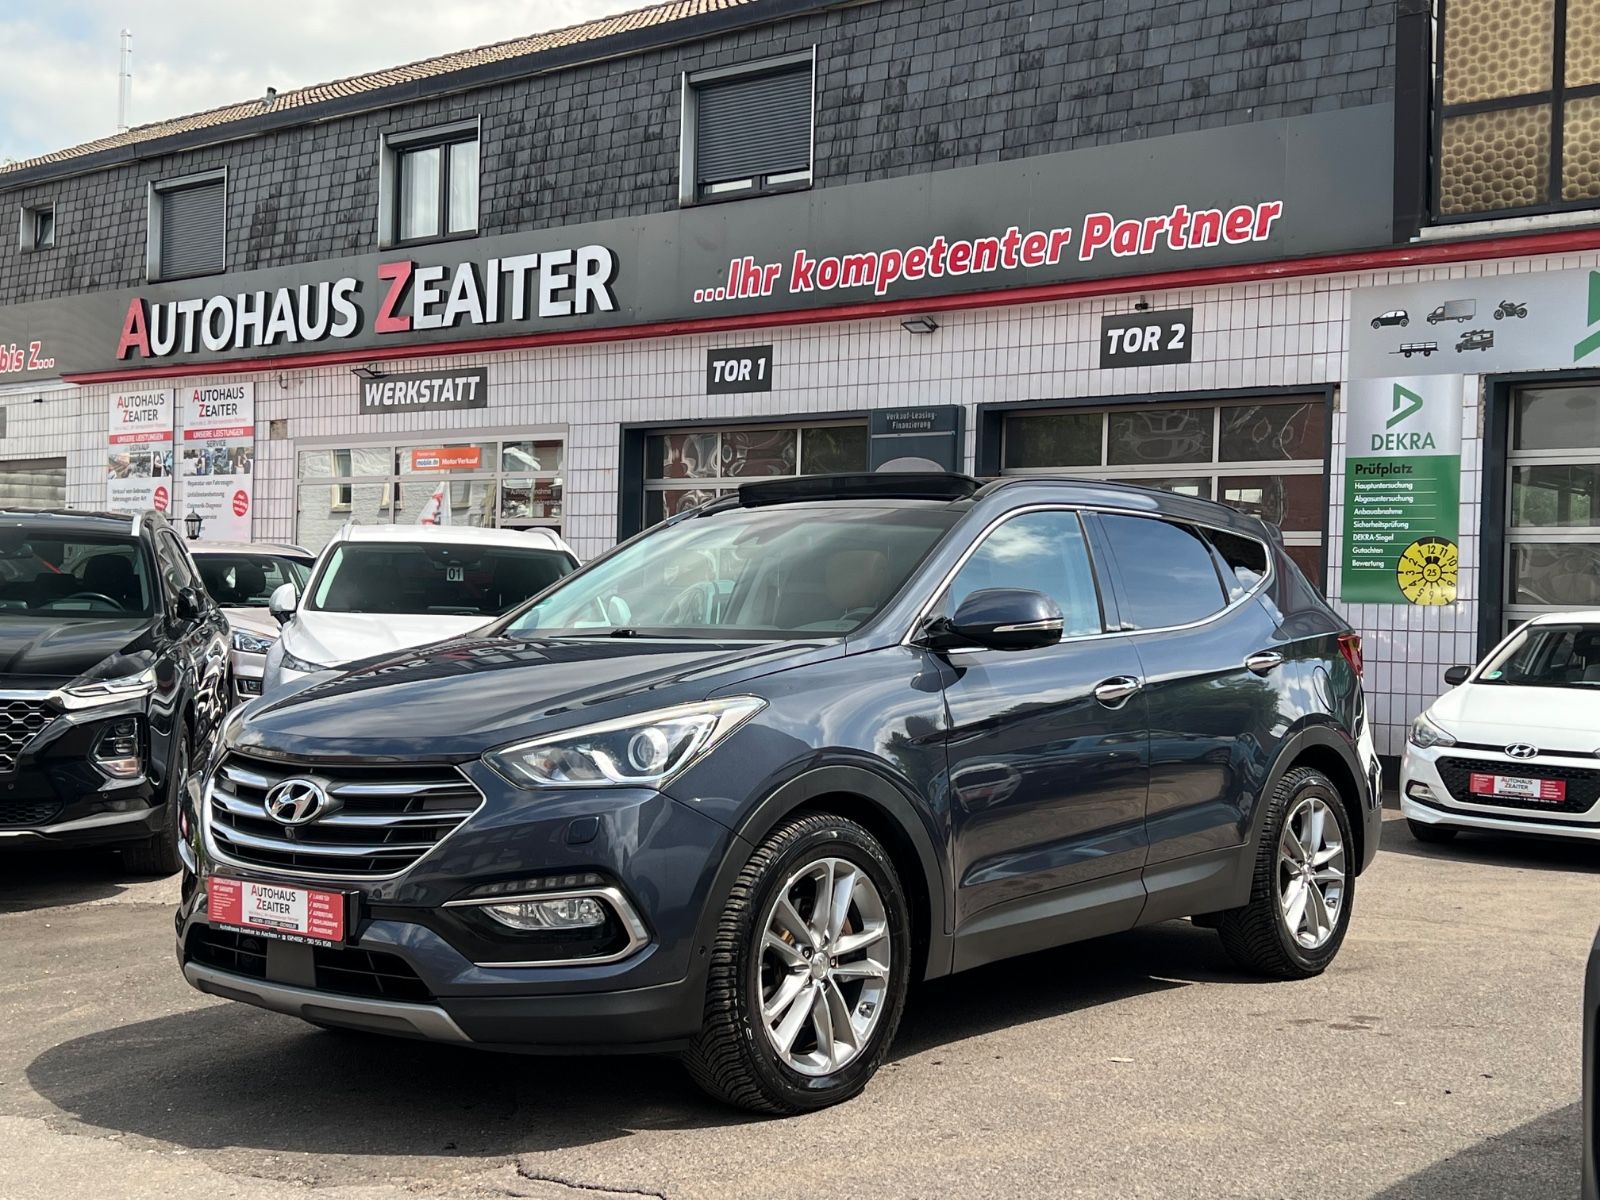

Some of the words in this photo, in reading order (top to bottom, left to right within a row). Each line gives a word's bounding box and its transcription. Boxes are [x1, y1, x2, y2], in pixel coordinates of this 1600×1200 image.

[693, 258, 780, 302] ...Ihr
[789, 226, 1071, 295] kompetenter
[1079, 200, 1283, 260] Partner
[117, 278, 361, 359] AUTOHAUS
[374, 245, 614, 334] ZEAITER
[1107, 325, 1162, 355] TOR
[1167, 323, 1186, 350] 2
[0, 343, 25, 374] bis
[713, 359, 752, 383] TOR
[757, 357, 766, 380] 1
[193, 387, 245, 402] AUTOHAUS
[365, 376, 481, 406] WERKSTATT
[117, 393, 165, 408] AUTOHAUS
[122, 409, 158, 423] ZEAITER
[198, 403, 238, 418] ZEAITER
[892, 421, 931, 429] Finanzierung
[206, 440, 227, 448] SERVICE
[1371, 432, 1436, 451] DEKRA
[1355, 462, 1413, 477] Prüfplatz
[1354, 481, 1413, 491] Hauptuntersuchung
[1354, 495, 1414, 503] Abgasuntersuchung
[1353, 520, 1409, 529] Sicherheitsprüfung
[1353, 533, 1394, 543] DEKRA-Siegel
[1417, 549, 1424, 558] 1
[1427, 545, 1436, 554] 12
[1439, 547, 1448, 558] 11
[1352, 560, 1385, 569] Bewertung
[1408, 558, 1418, 566] 2
[1447, 555, 1457, 567] 10
[448, 567, 461, 580] 01
[1427, 569, 1437, 577] 25
[1417, 588, 1425, 597] 5
[1501, 777, 1533, 785] AUTOHAUS
[1504, 783, 1529, 791] ZEAITER
[251, 884, 296, 902] AUTOHAUS
[256, 898, 290, 914] ZEAITER
